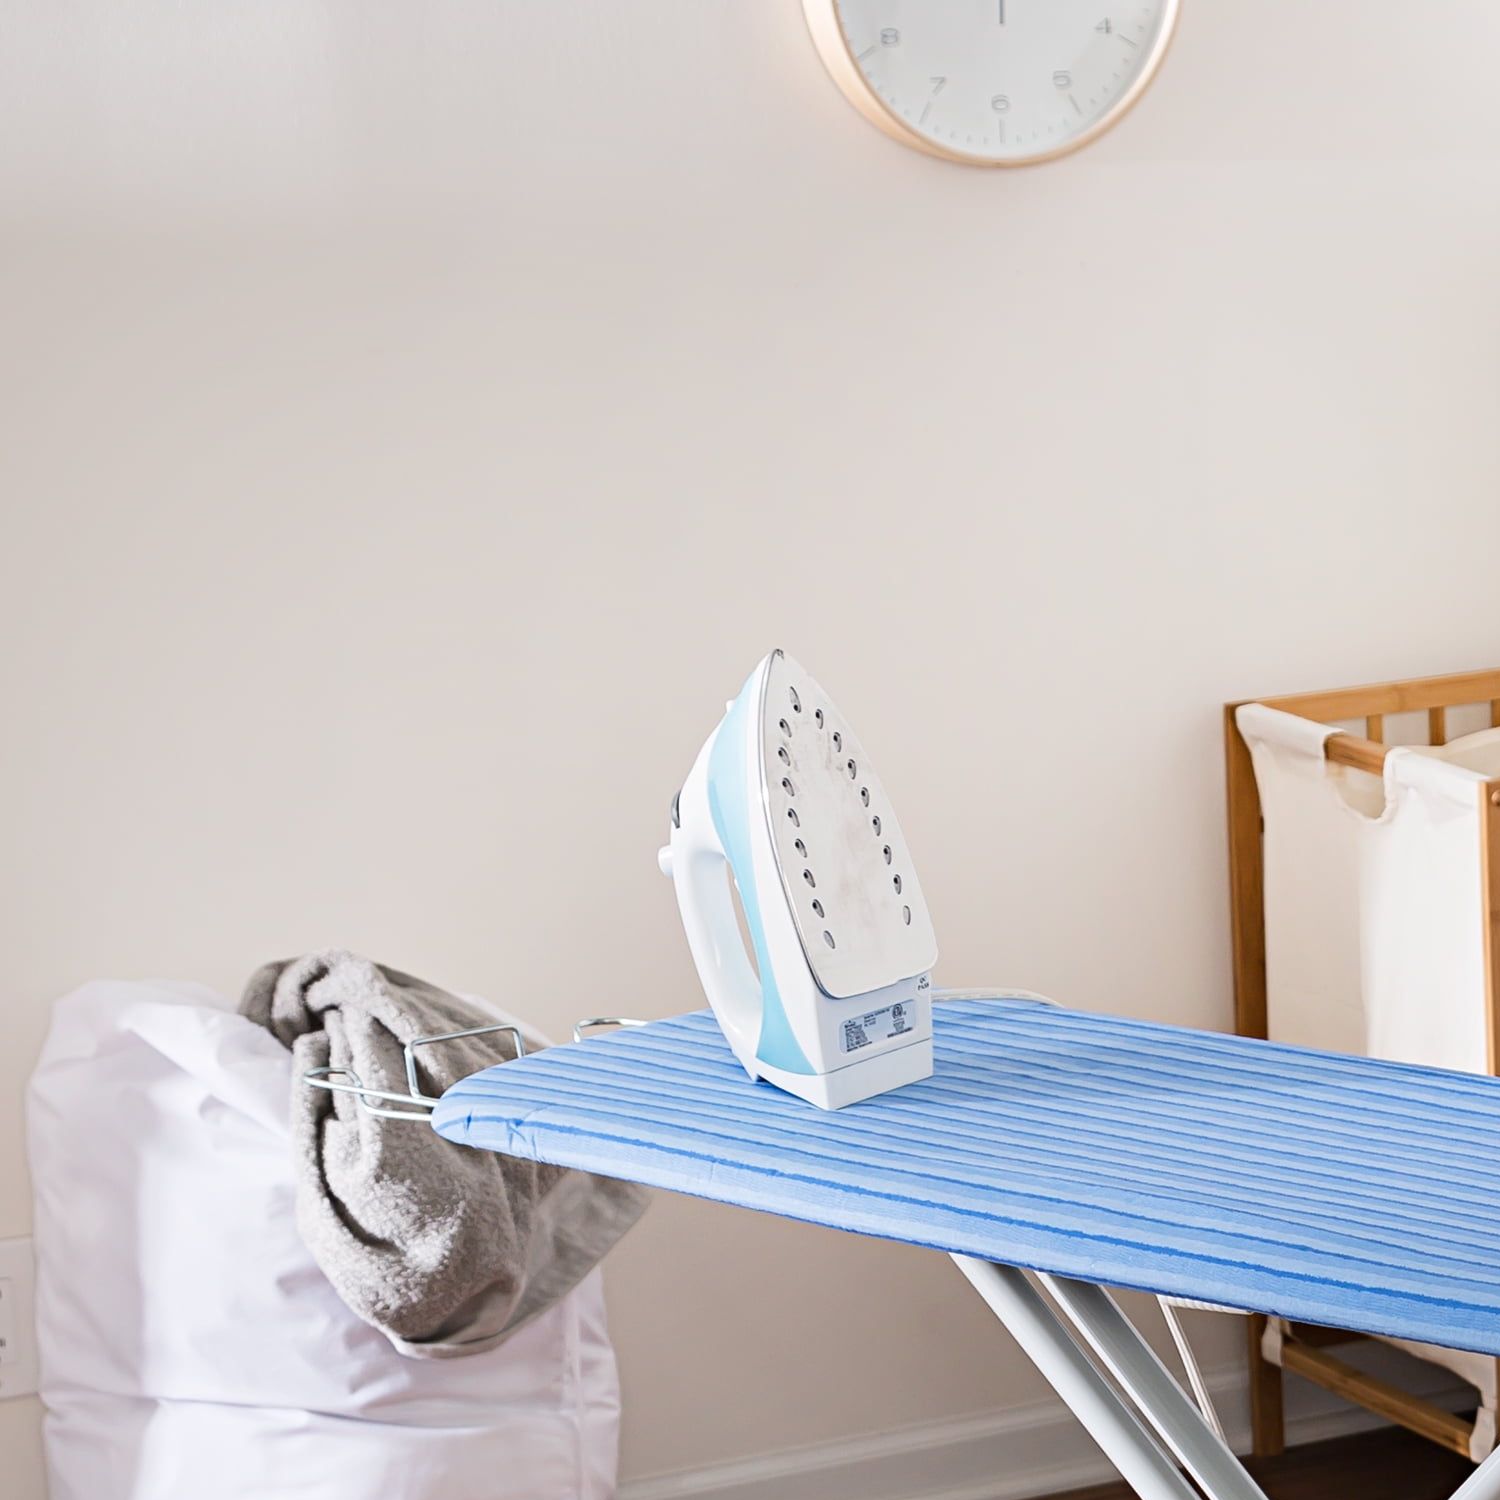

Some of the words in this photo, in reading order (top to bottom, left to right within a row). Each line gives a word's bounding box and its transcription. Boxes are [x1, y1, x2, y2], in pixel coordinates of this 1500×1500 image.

[1095, 17, 1112, 34] 4
[880, 28, 899, 45] 8
[930, 76, 946, 96] 7
[1052, 70, 1072, 88] 5
[991, 94, 1010, 112] 6
